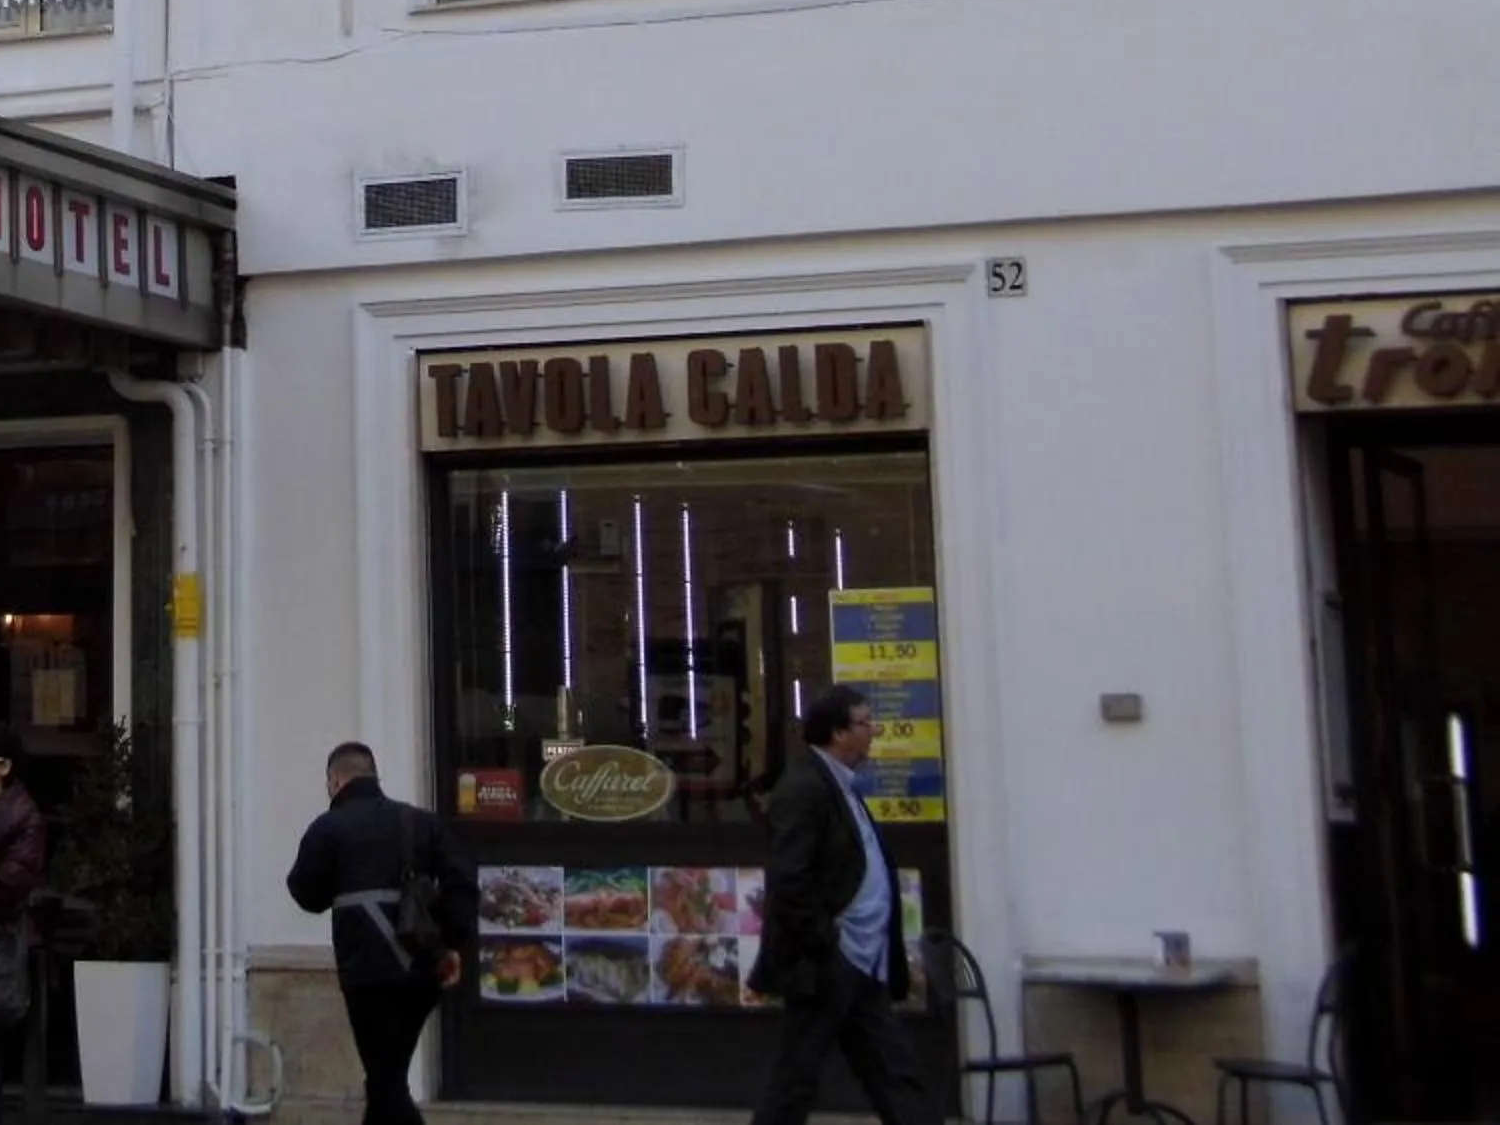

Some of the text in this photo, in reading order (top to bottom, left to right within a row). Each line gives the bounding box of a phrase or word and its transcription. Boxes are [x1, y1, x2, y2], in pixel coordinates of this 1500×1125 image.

[991, 261, 1023, 292] 52
[428, 340, 907, 438] TAVOLA CALDA
